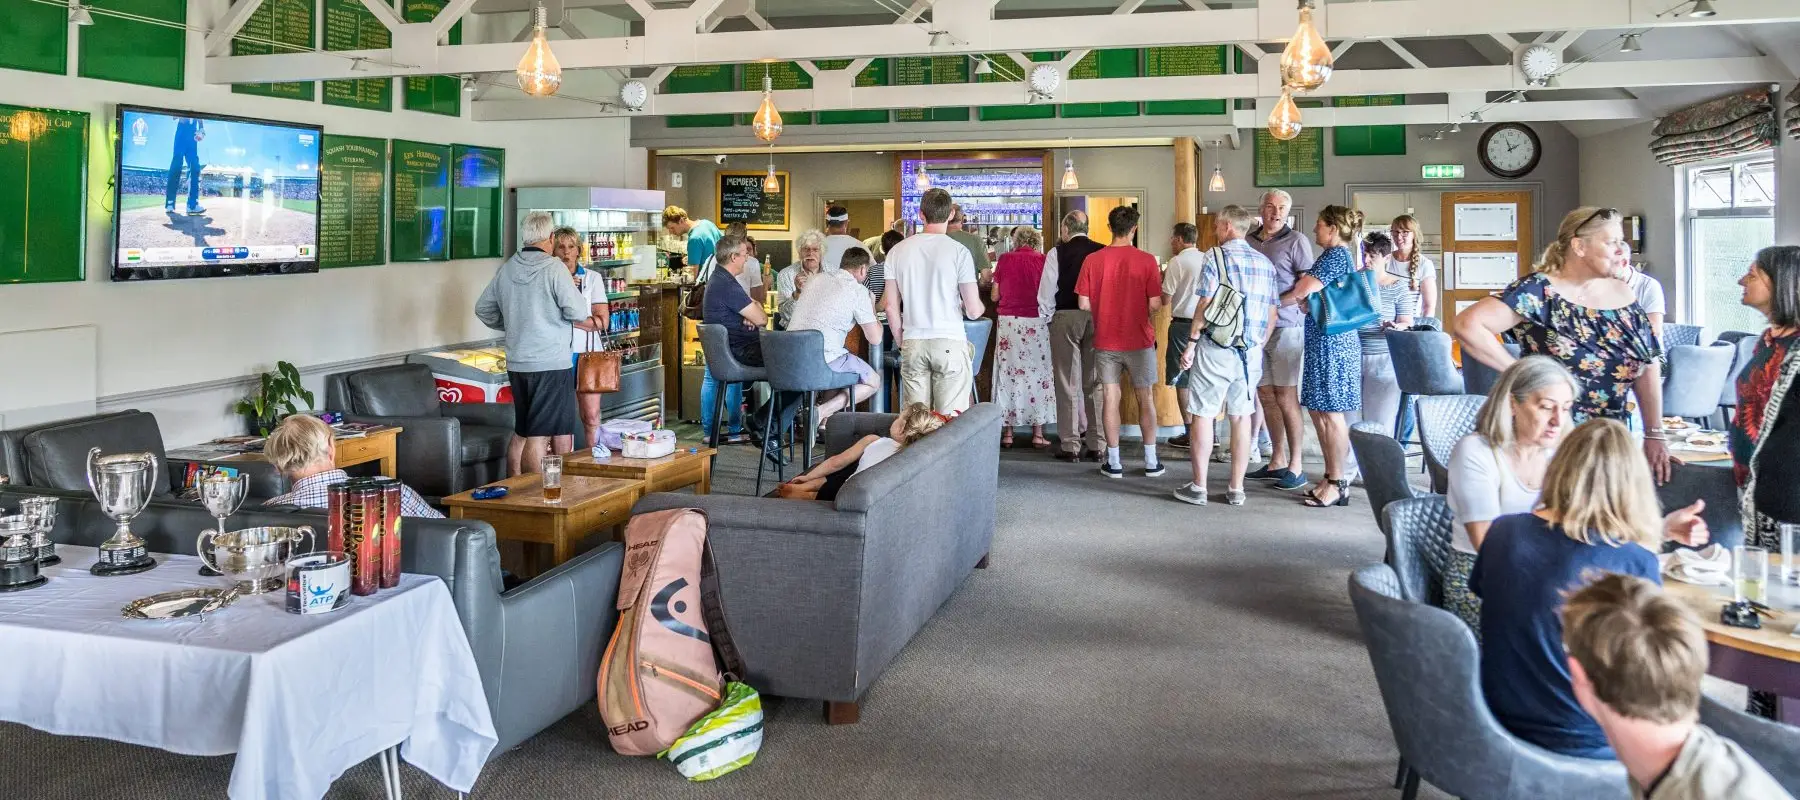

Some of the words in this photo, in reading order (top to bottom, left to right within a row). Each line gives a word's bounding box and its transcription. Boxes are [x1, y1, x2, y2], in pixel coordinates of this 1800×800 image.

[326, 145, 345, 156] SQUASH
[726, 177, 758, 188] MEMBERS
[627, 539, 659, 552] HEAD
[309, 594, 334, 606] ATP
[607, 720, 649, 737] HEAD
